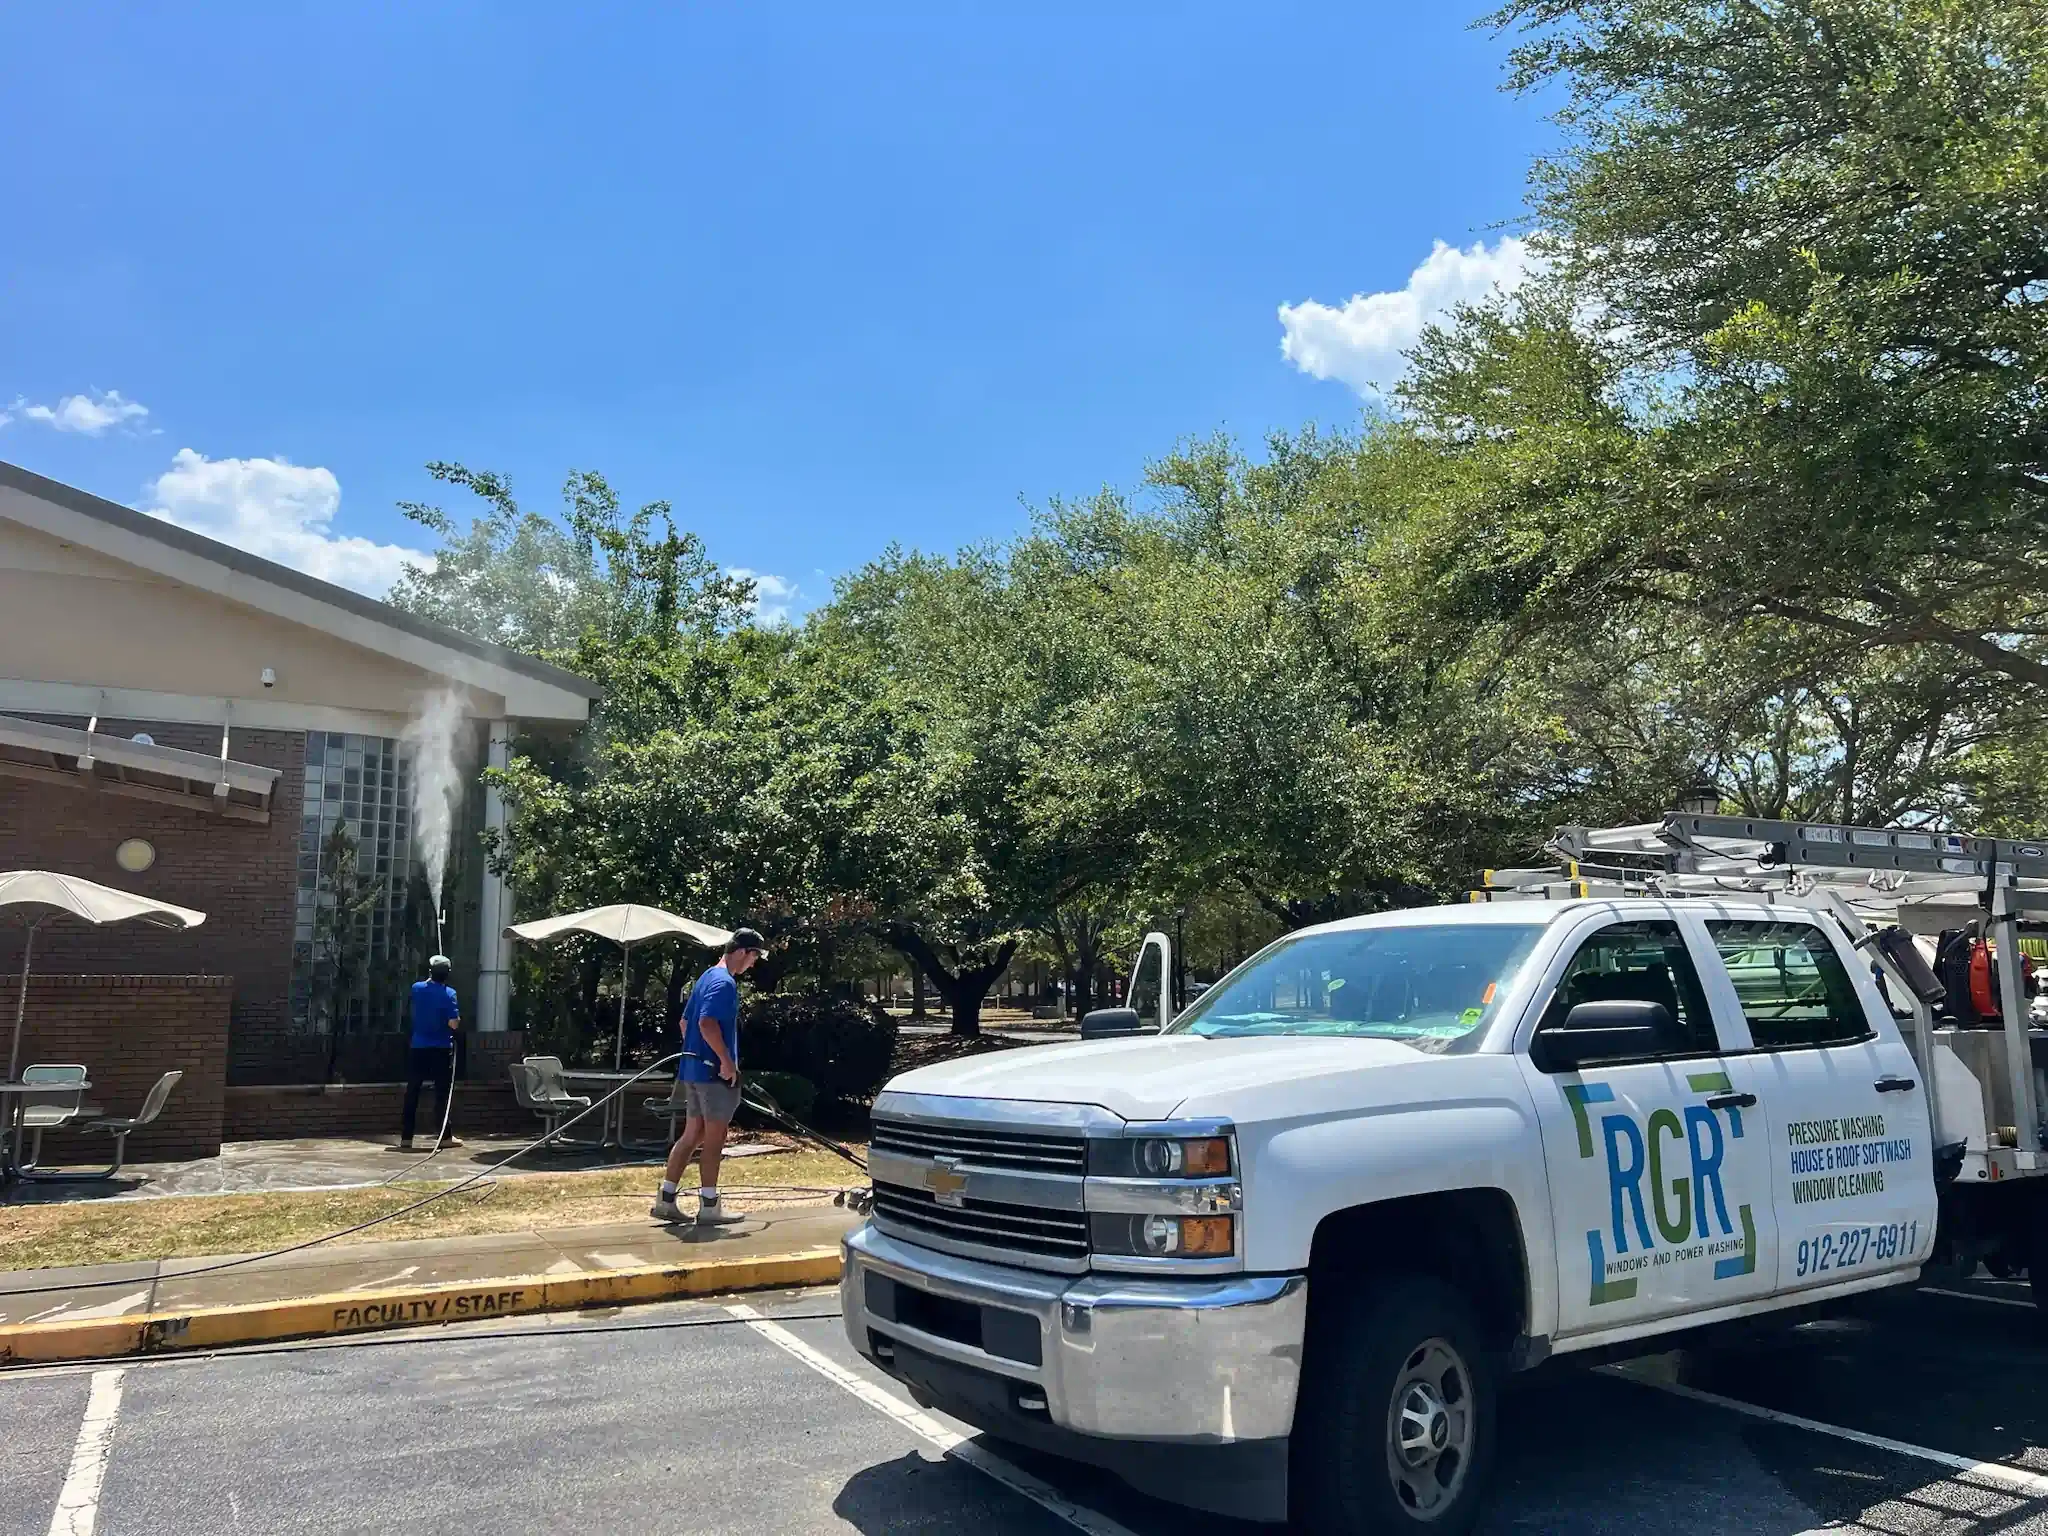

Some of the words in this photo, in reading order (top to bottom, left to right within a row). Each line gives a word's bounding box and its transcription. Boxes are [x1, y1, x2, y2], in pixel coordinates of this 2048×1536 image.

[1787, 1119, 1840, 1146] PRESSURE
[1841, 1114, 1885, 1140] WASHING
[1791, 1148, 1825, 1174] HOUSE
[1827, 1148, 1834, 1170] &
[1836, 1145, 1860, 1169] ROOF
[1862, 1138, 1912, 1166] SOFTWASH
[1601, 1105, 1734, 1254] RGR
[1792, 1177, 1836, 1205] WINDOW
[1837, 1170, 1884, 1198] CLEANING
[1605, 1257, 1648, 1276] WINDOWS
[1652, 1251, 1671, 1267] AND
[1675, 1245, 1704, 1262] POWER
[1707, 1238, 1744, 1256] WASHING
[1796, 1220, 1917, 1277] 912-227-6911
